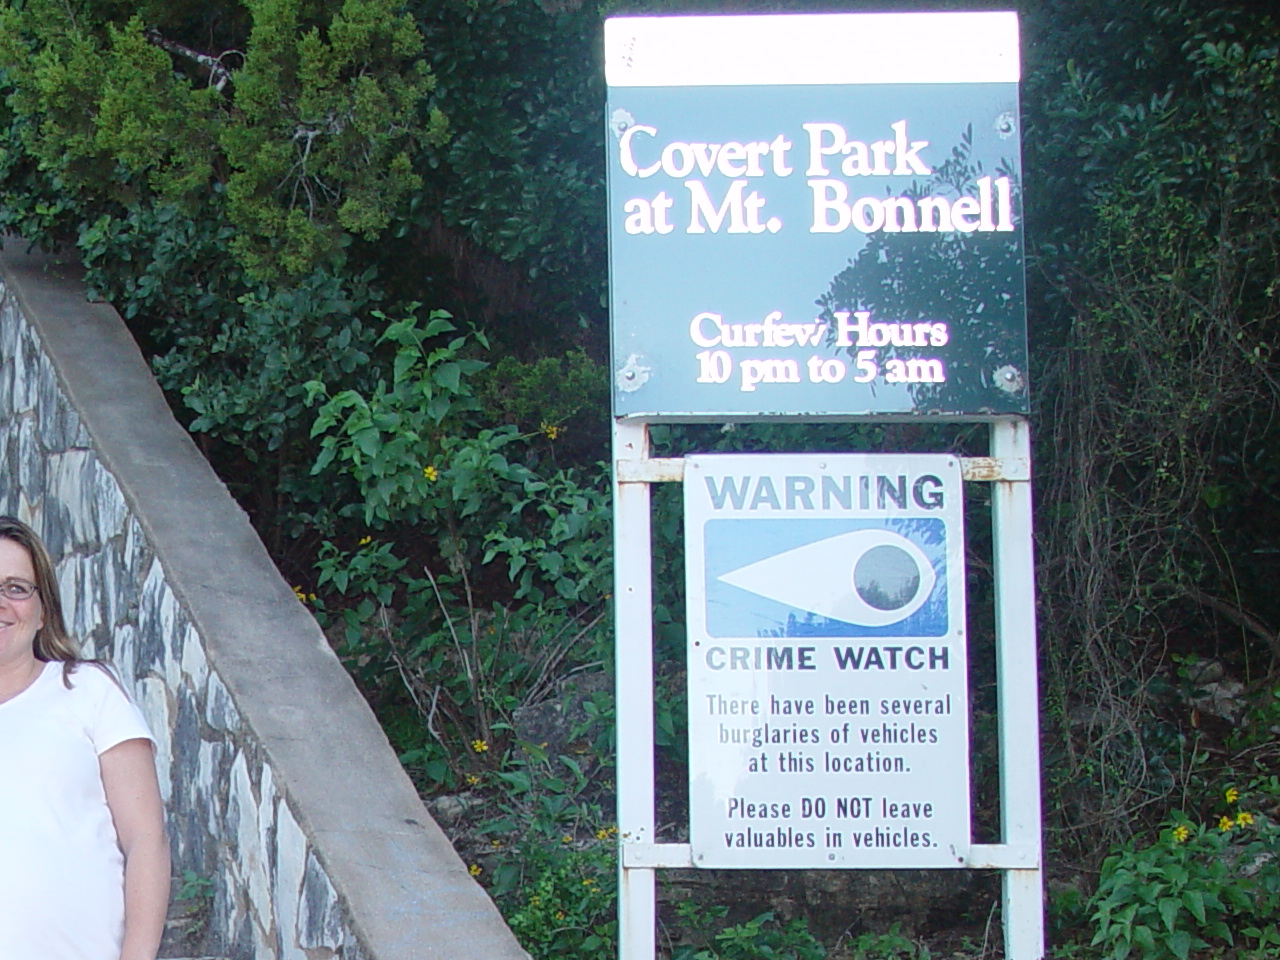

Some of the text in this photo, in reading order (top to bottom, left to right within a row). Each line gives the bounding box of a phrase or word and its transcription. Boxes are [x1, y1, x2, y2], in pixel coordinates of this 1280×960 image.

[620, 120, 931, 178] Covert Park
[624, 176, 1014, 234] at Mt. Bonnell
[689, 311, 949, 347] Curfew Hours
[696, 350, 945, 391] 10 pm to 5 am
[705, 474, 945, 510] WARNING
[705, 646, 950, 671] CRIME WATCH
[706, 694, 951, 715] There have been several
[719, 723, 938, 748] burglaries of vehicles
[748, 751, 911, 772] at this location.
[728, 797, 933, 819] Please DO NOT leave
[724, 827, 938, 848] valuables in vehicles.
